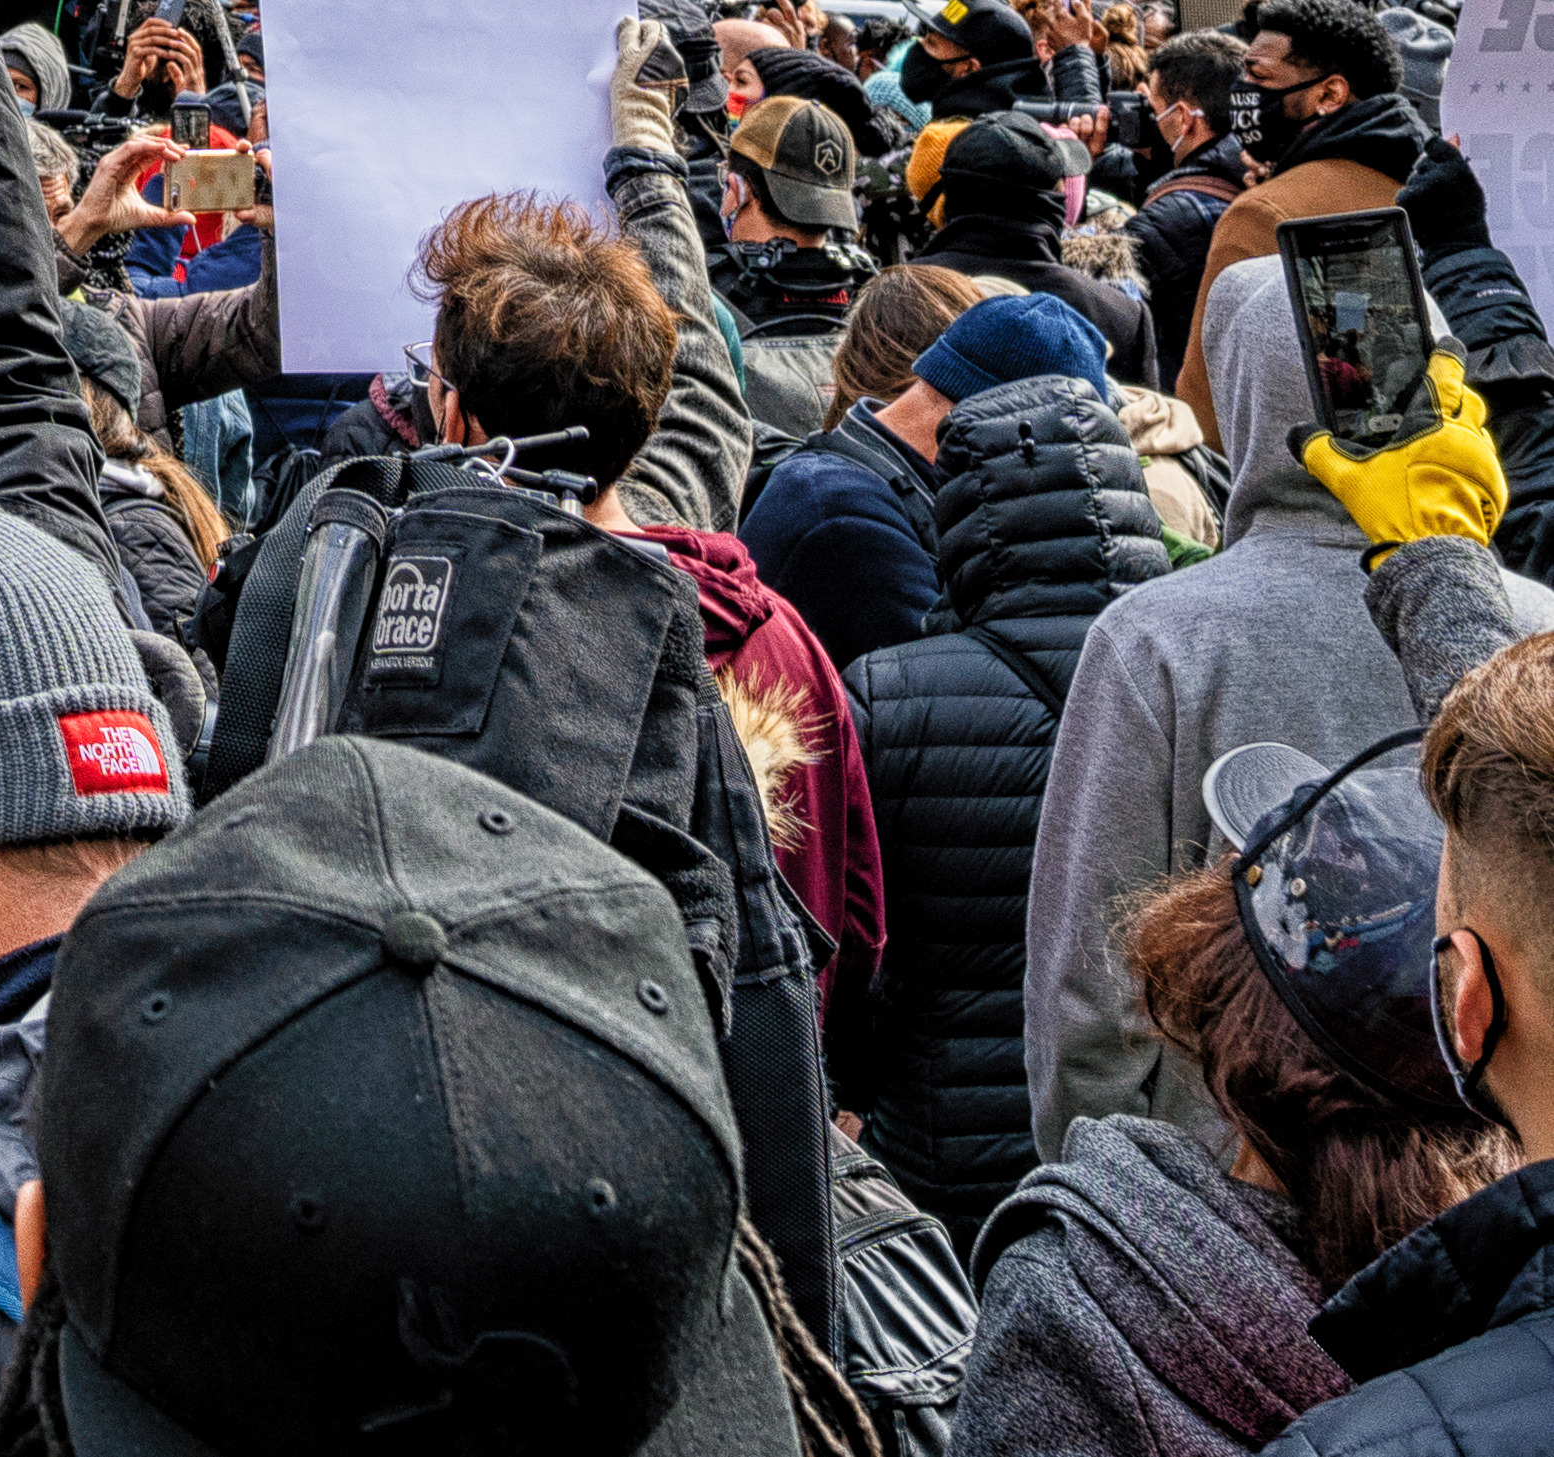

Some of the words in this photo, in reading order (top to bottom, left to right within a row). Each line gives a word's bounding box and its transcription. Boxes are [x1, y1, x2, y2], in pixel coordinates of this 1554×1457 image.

[99, 726, 133, 743] THE
[78, 742, 136, 763] NORTH
[100, 757, 140, 775] FACE
